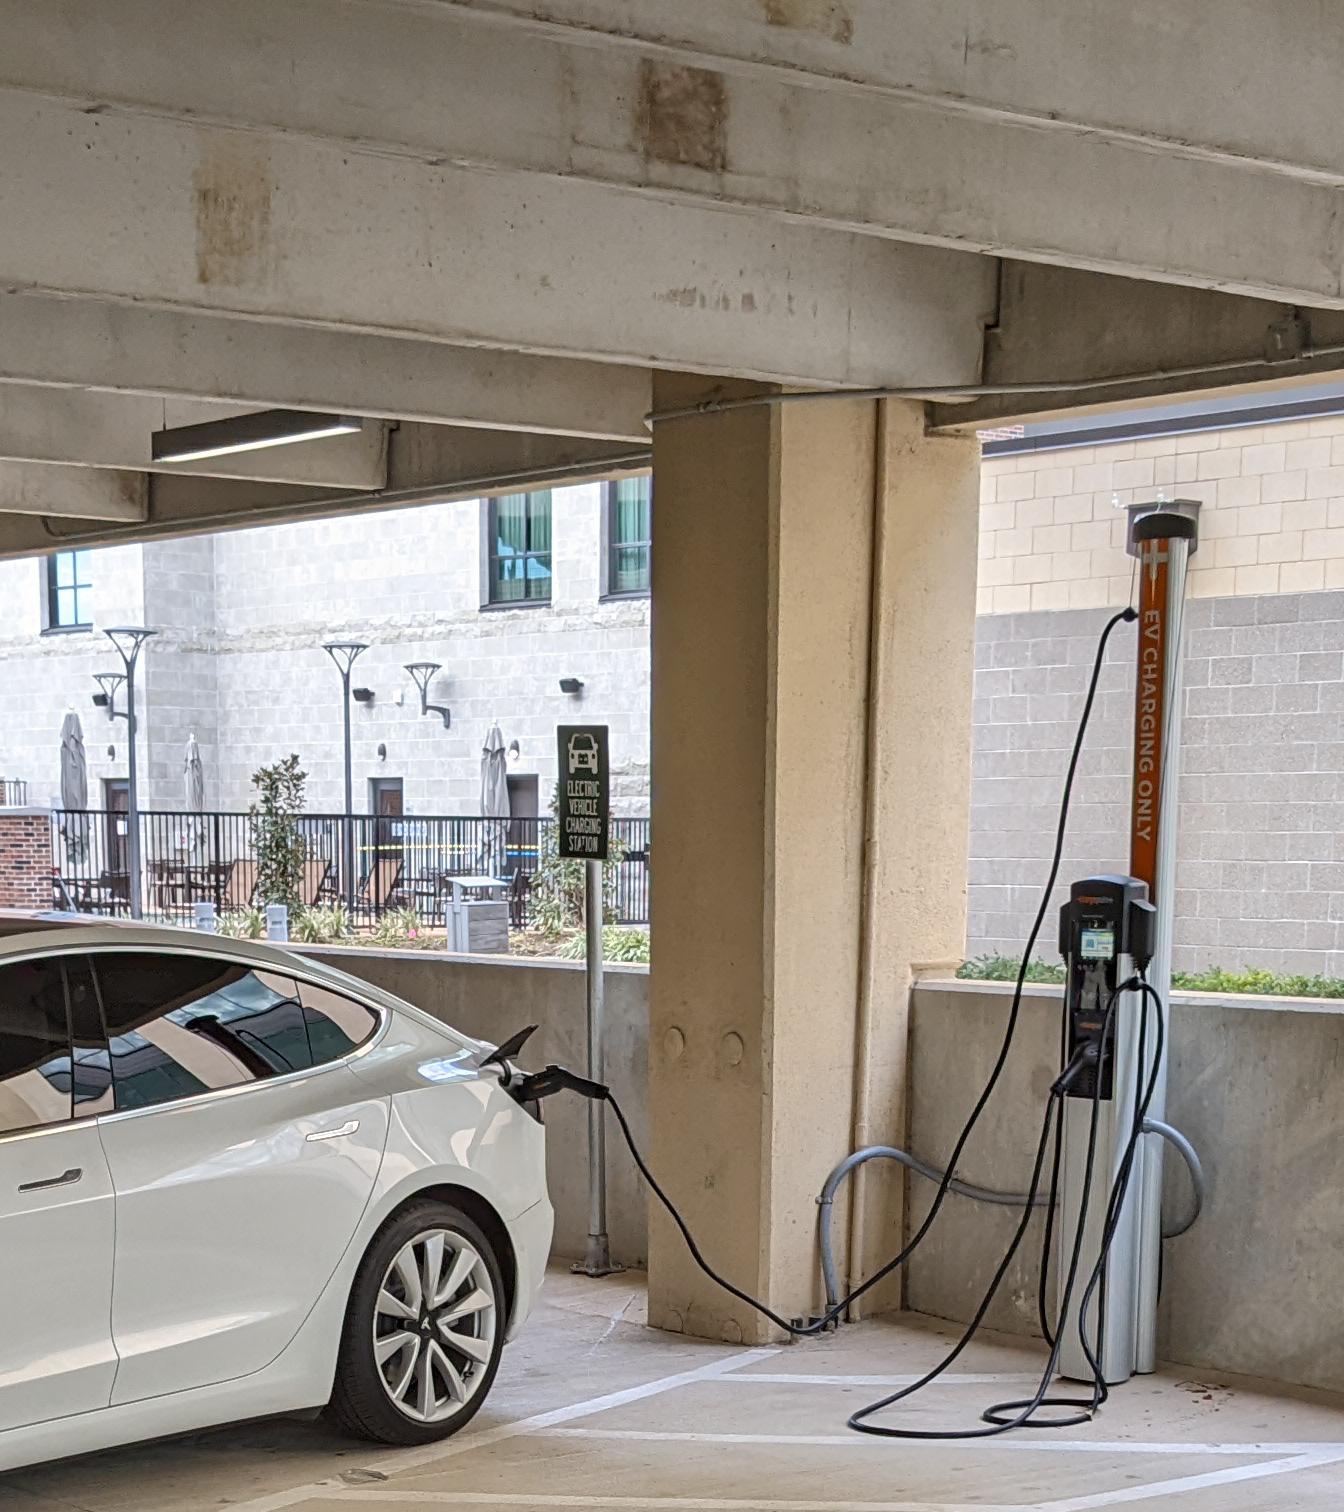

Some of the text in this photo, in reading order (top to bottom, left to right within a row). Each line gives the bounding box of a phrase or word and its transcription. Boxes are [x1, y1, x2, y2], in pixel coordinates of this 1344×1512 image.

[1137, 609, 1160, 841] EV CHARGING ONLY
[567, 780, 600, 798] ELECTRIC
[568, 798, 598, 816] VEHICLE
[565, 817, 602, 835] CHARGING
[568, 835, 599, 853] STATION
